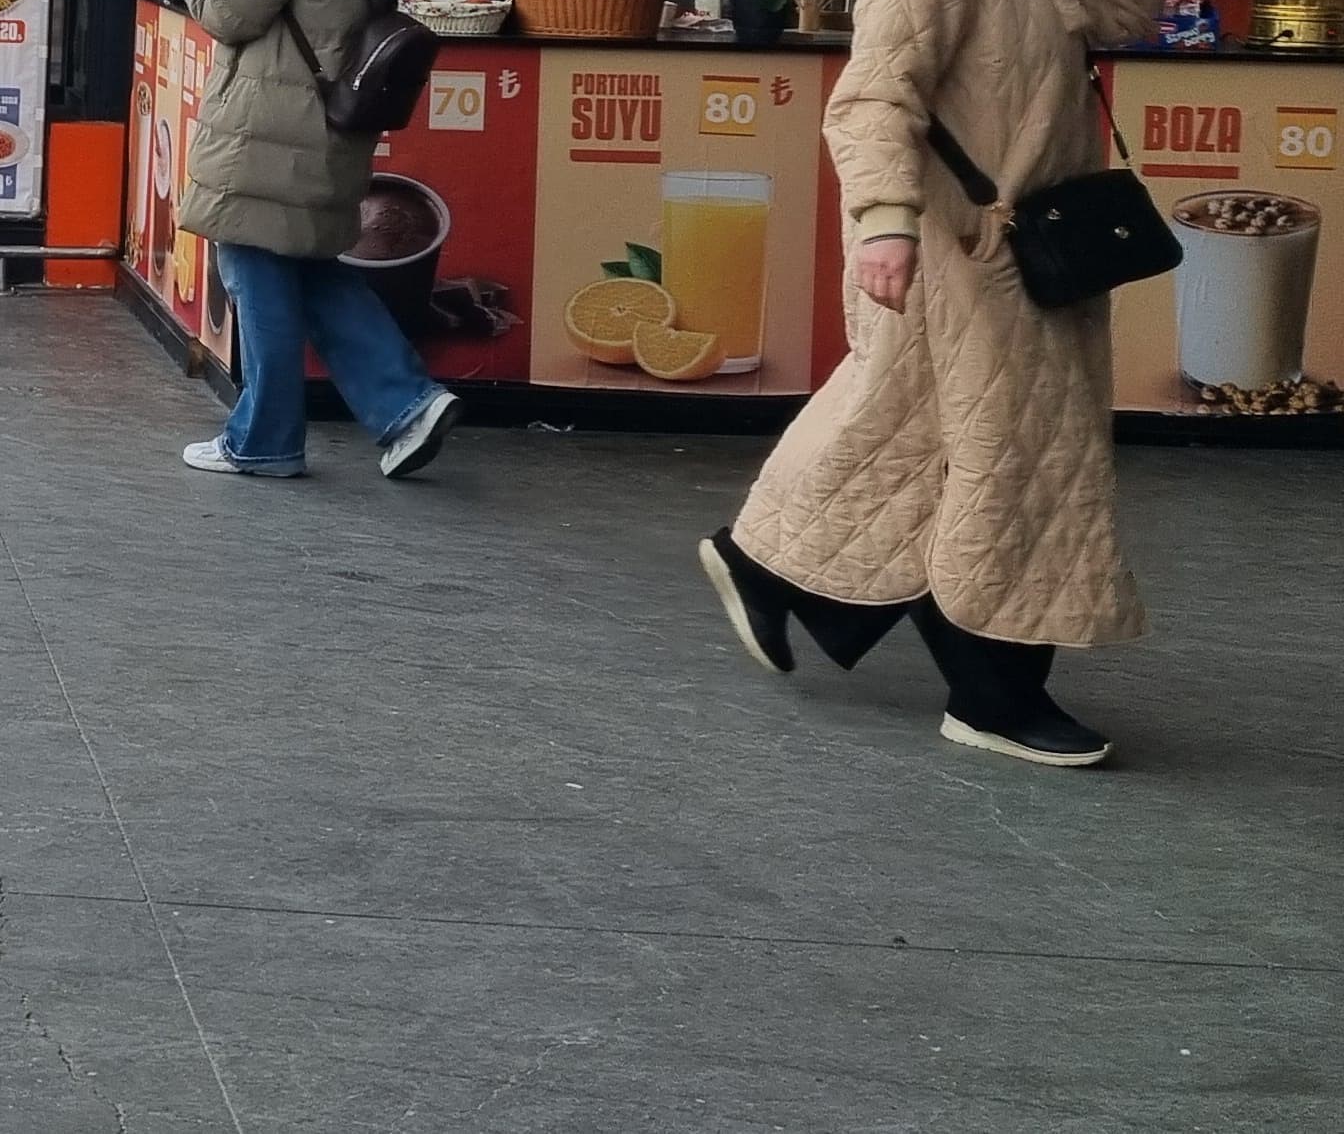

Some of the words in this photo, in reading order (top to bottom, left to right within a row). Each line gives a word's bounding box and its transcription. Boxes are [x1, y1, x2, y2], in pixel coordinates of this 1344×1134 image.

[572, 73, 661, 96] PORTAKAL
[434, 87, 481, 116] 70
[705, 93, 755, 124] 80
[572, 97, 661, 142] SUYU
[1143, 105, 1241, 153] BOZA
[1279, 126, 1333, 157] 80
